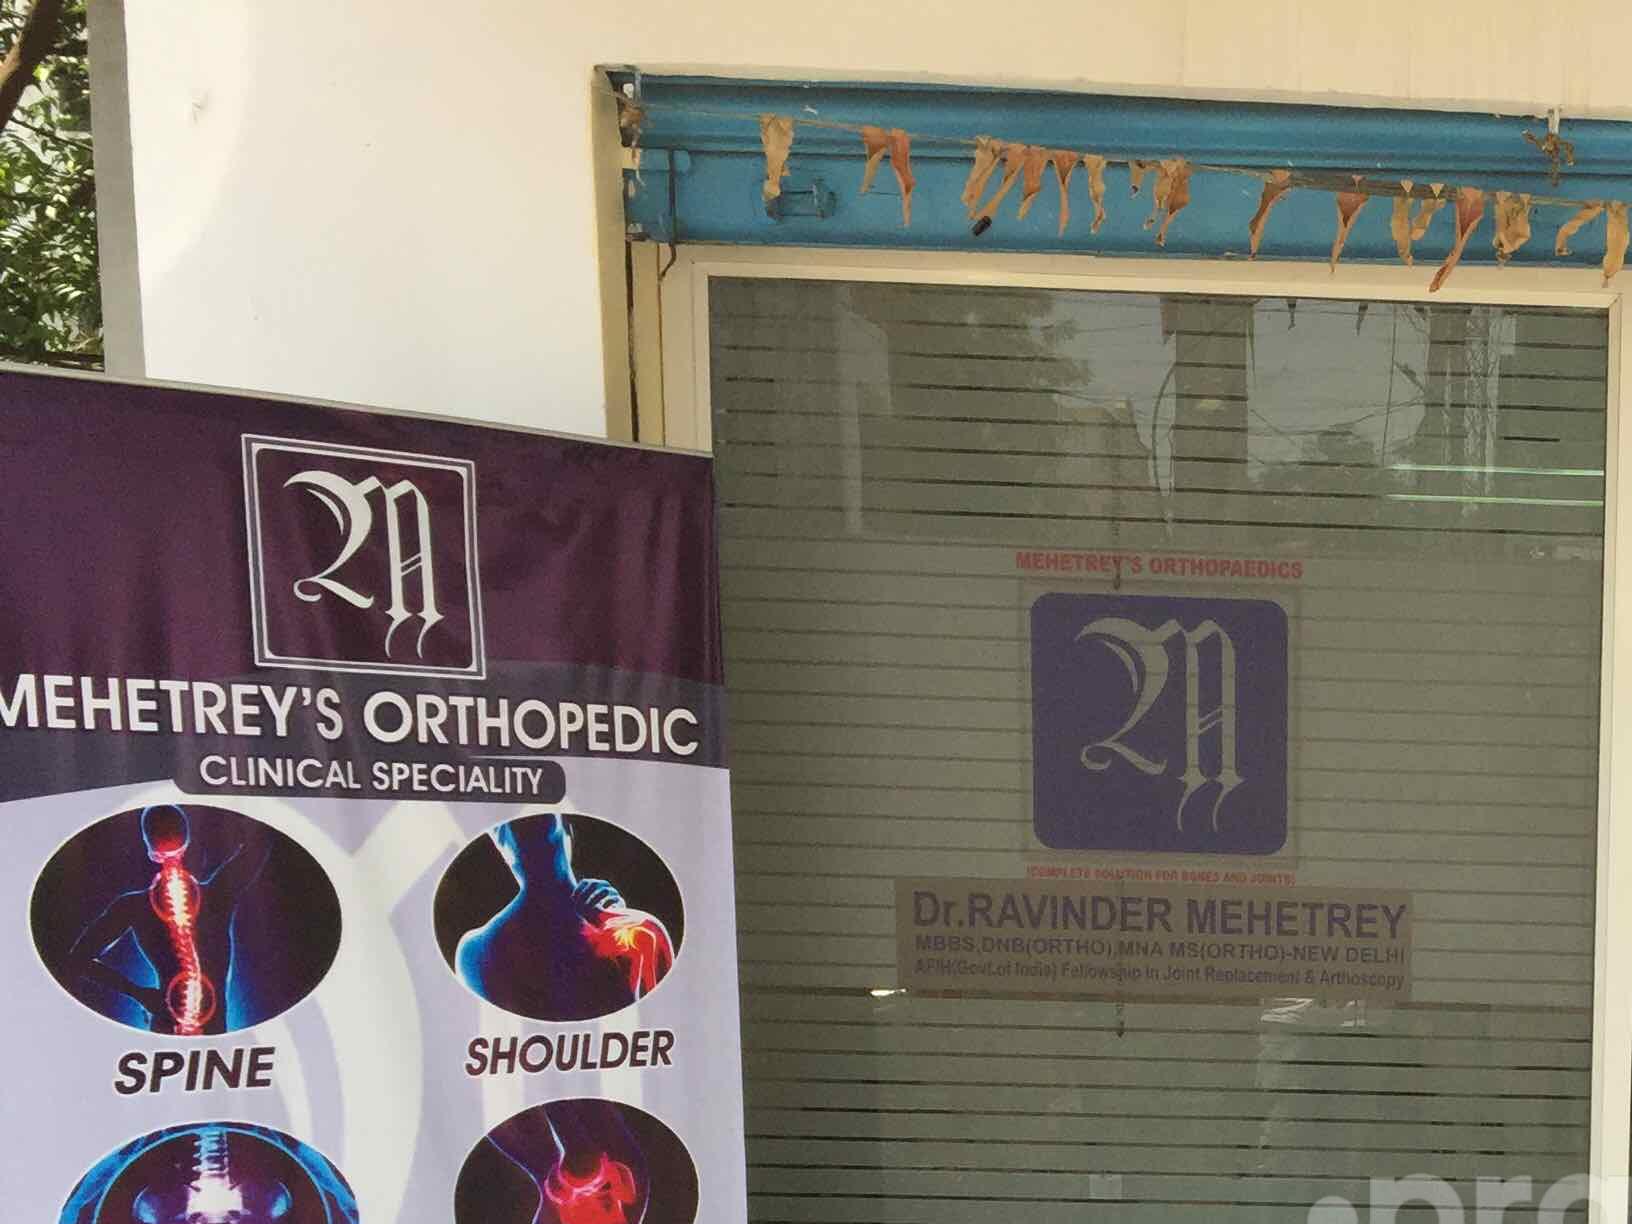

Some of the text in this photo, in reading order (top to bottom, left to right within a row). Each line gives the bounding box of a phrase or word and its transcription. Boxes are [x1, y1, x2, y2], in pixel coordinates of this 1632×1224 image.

[1015, 552, 1304, 578] MEHETREY'S ORTHOPAEDICS
[364, 692, 699, 755] ORTHOPEDIC
[200, 755, 543, 795] CLINICAL SPECIALITY
[913, 890, 1406, 939] Dr.RAVINDER MEHETREY
[1345, 946, 1405, 964] DELHI
[114, 1047, 276, 1095] SPINE
[465, 1030, 674, 1076] SHOULDER
